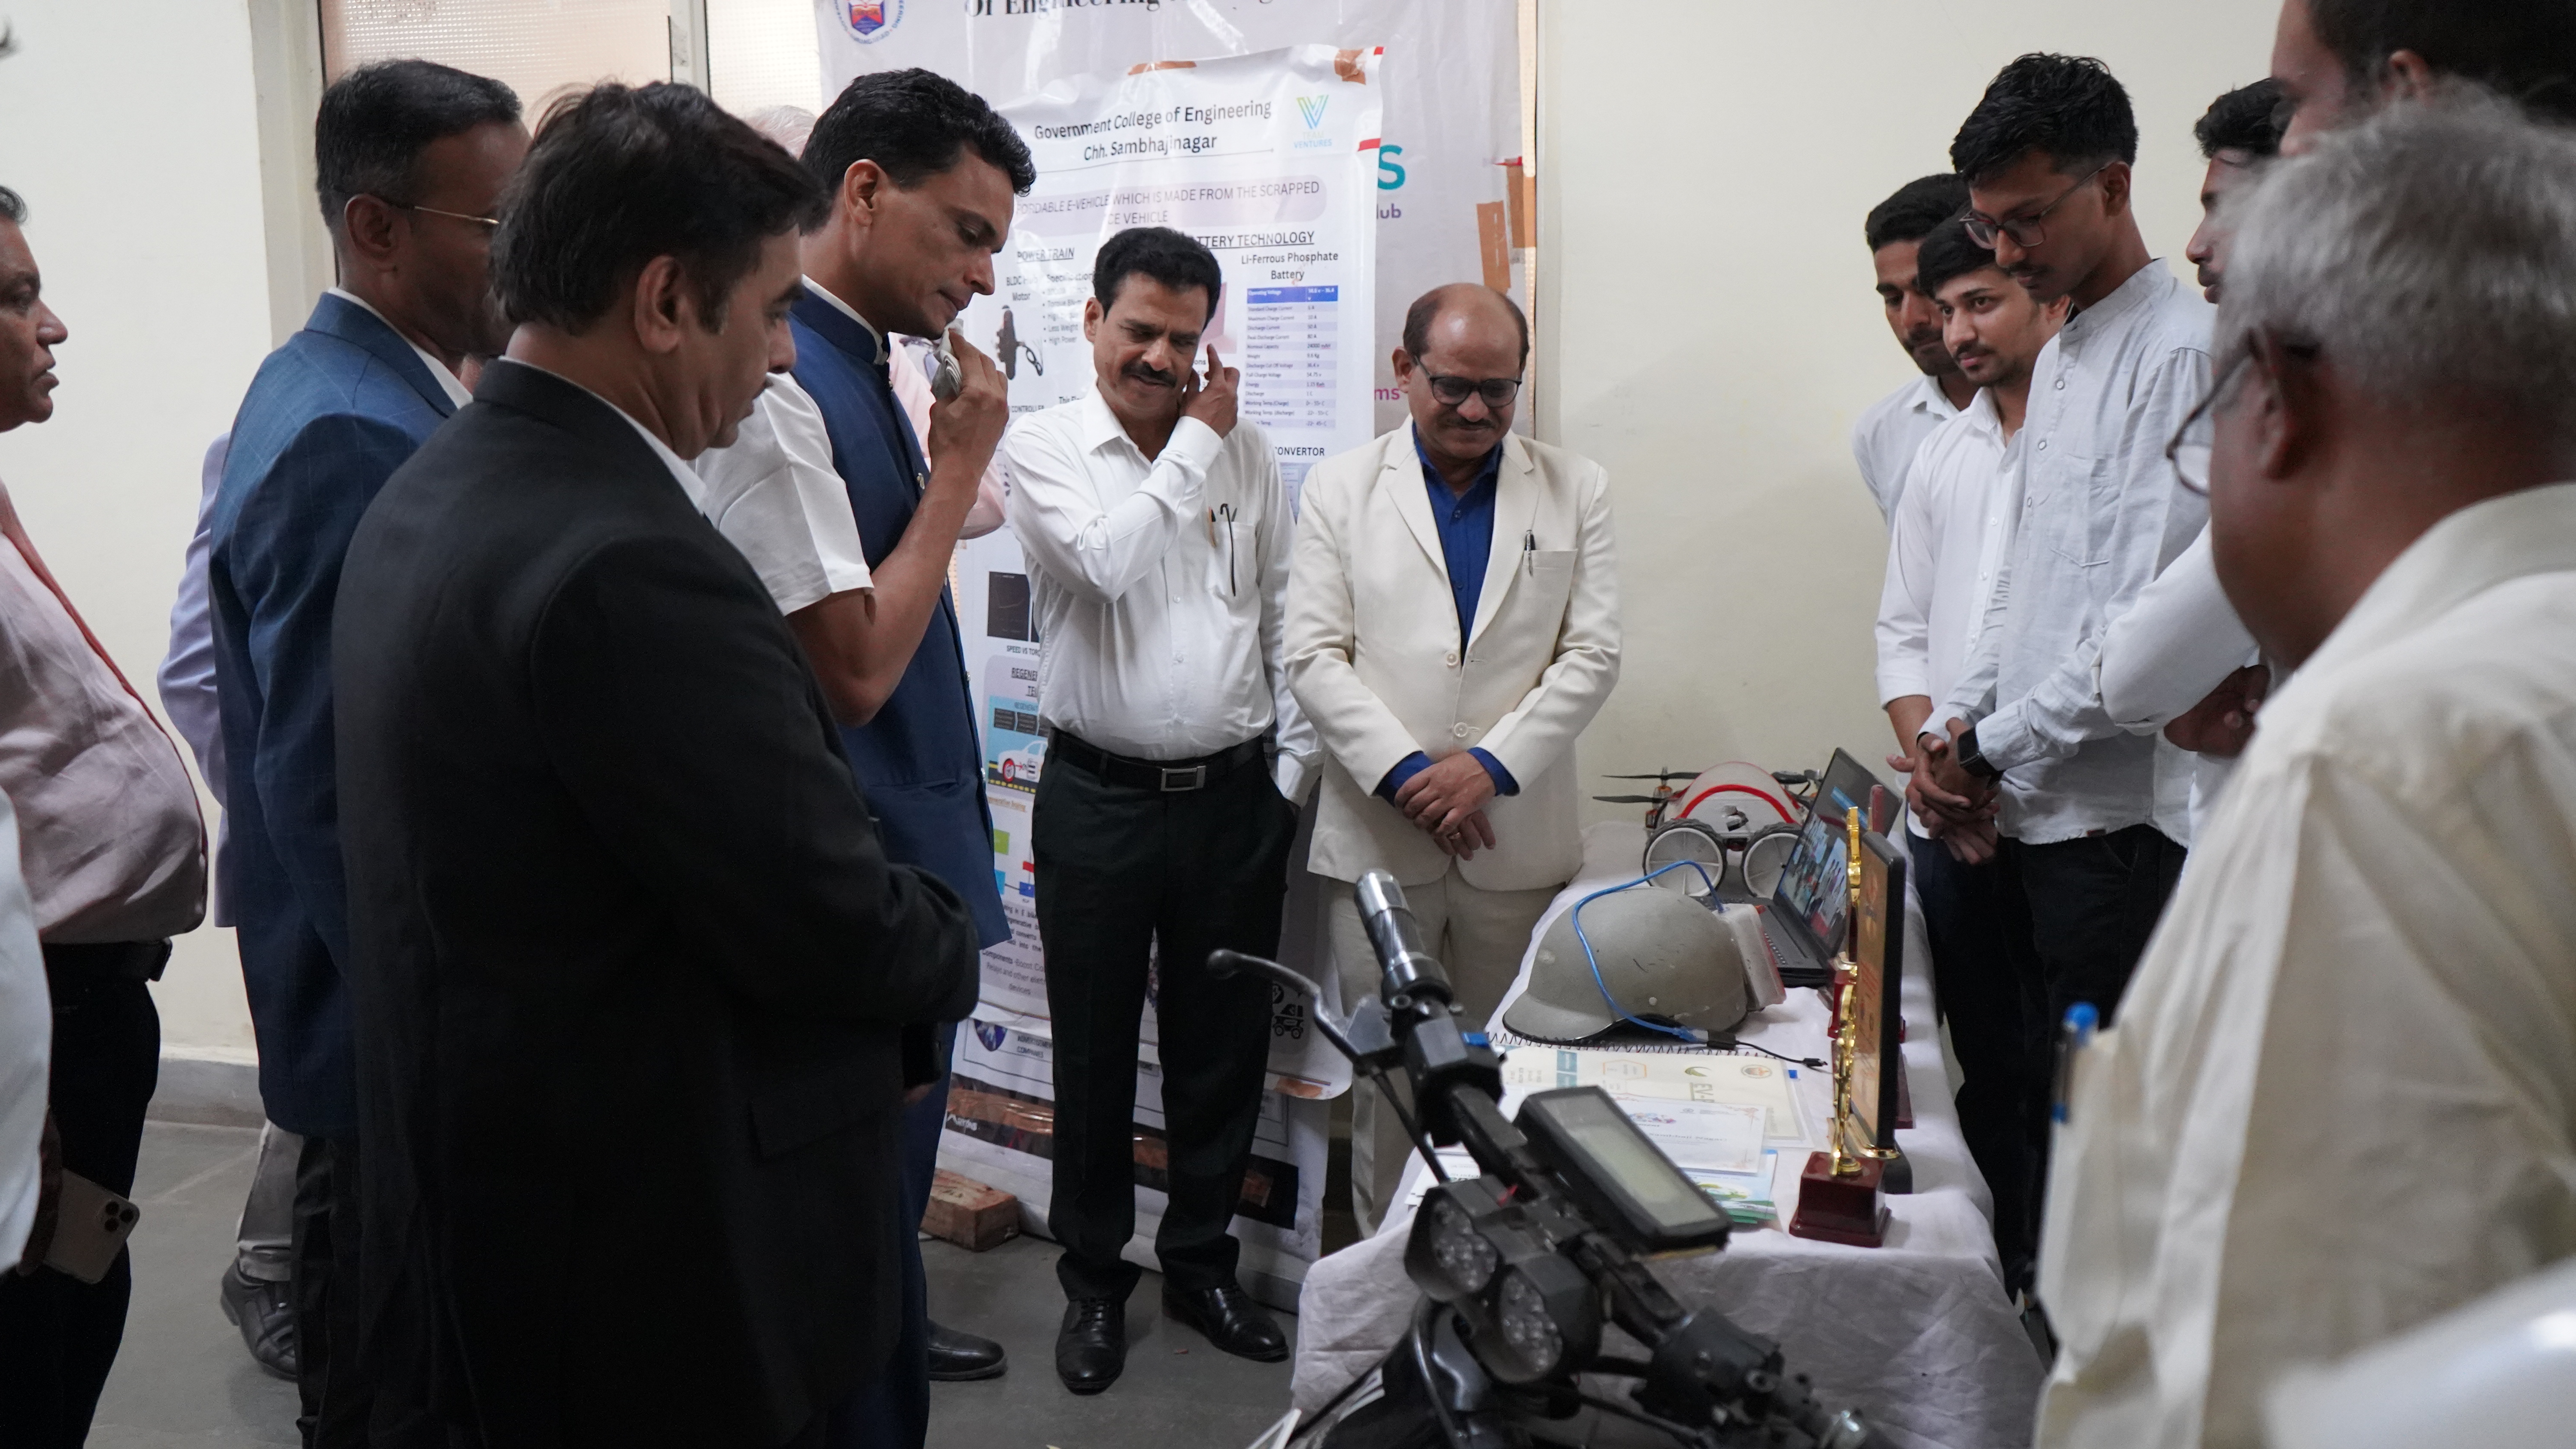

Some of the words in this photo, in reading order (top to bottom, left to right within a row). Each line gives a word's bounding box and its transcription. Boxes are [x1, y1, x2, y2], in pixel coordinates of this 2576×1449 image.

[1034, 118, 1111, 139] Government
[1114, 110, 1161, 130] College
[1166, 107, 1181, 123] of
[1185, 100, 1272, 125] Engineering
[1083, 146, 1108, 161] Chh.
[1111, 135, 1218, 156] Sambhajinagar
[1294, 139, 1333, 149] VENTURES
[1067, 194, 1109, 211] E-VEHICLE
[1113, 192, 1150, 206] WHICH
[1153, 192, 1162, 203] IS
[1164, 188, 1196, 202] MADE
[1199, 188, 1233, 200] FROM
[1236, 185, 1257, 199] THE
[1260, 181, 1320, 197] SCRAPPED
[1124, 210, 1168, 224] VEHICLE
[1237, 231, 1315, 247] TECHNOLOGY
[1017, 249, 1045, 261] POWER
[1048, 247, 1075, 260] TRAIN
[1241, 254, 1285, 264] Li-Ferrous
[1288, 252, 1338, 265] Phosphate
[1271, 270, 1305, 281] Battery
[1012, 292, 1031, 301] Motor
[1374, 388, 1400, 400] ms
[1276, 447, 1325, 456] ONVERTOR
[1006, 645, 1021, 654] SPEED
